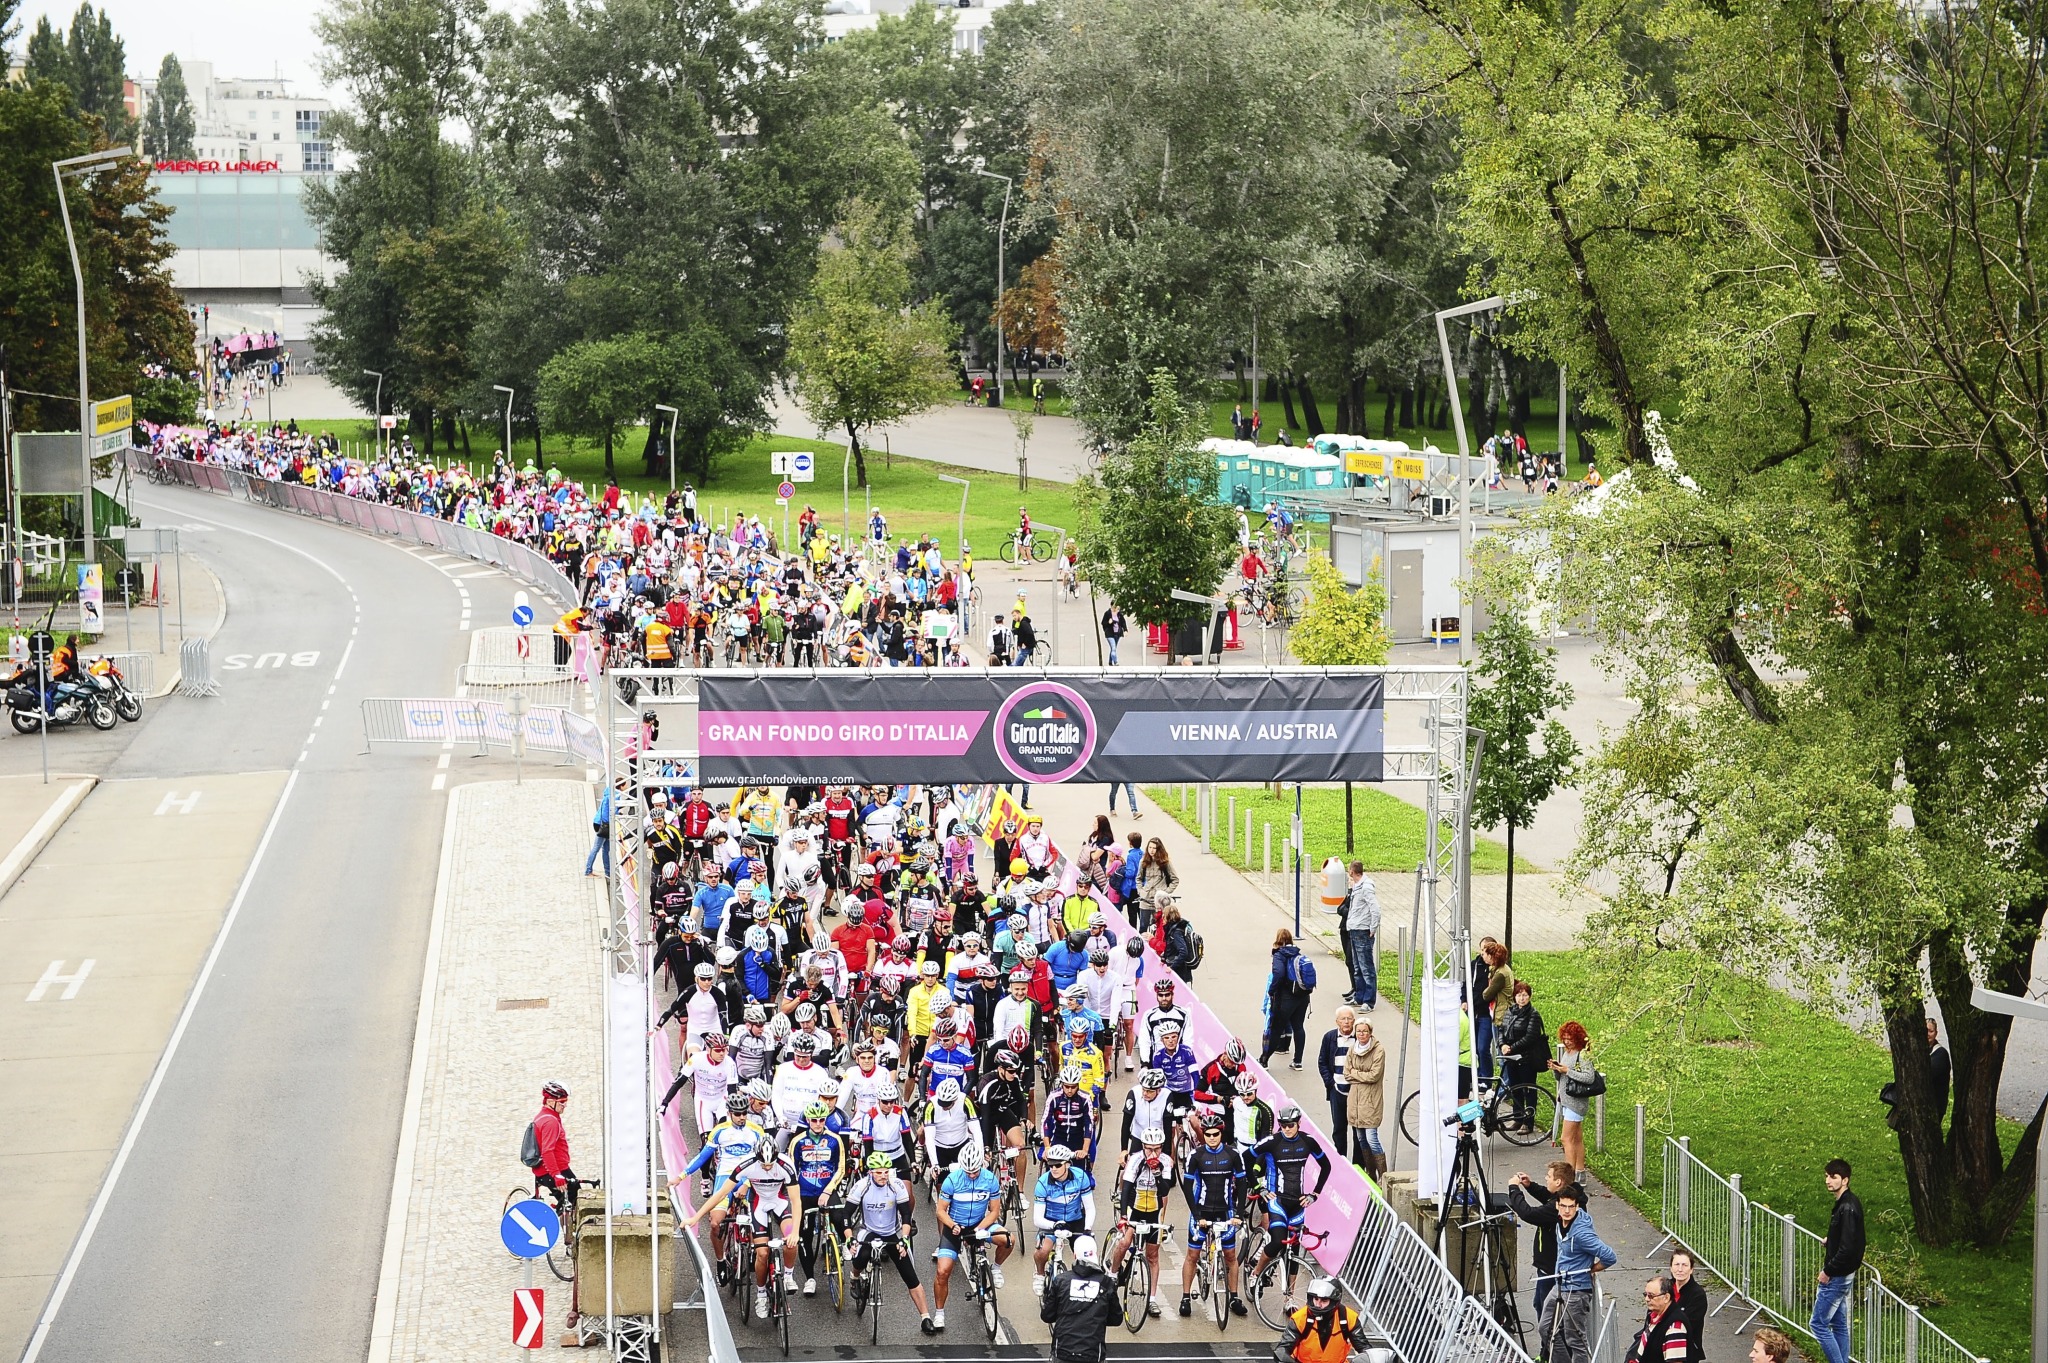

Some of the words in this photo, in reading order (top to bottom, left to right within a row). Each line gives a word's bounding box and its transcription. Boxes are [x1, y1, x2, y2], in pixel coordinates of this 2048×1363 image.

[155, 160, 221, 172] WIENER
[226, 160, 278, 172] LINIEN
[1355, 459, 1382, 470] ERFRISCHENDES
[1404, 463, 1422, 474] IMBISS
[221, 651, 321, 670] BUS
[708, 724, 762, 741] GRAN
[768, 724, 834, 741] FONDO
[838, 724, 884, 741] GIRO
[1010, 722, 1037, 744] Giro
[1038, 722, 1080, 744] d'Italia
[1169, 724, 1241, 741] VIENNA
[1256, 723, 1338, 740] AUSTRIA
[1018, 746, 1042, 755] GRAN
[1043, 745, 1073, 755] FONDO
[707, 774, 855, 786] www.granfondovienna.com
[153, 791, 202, 815] H
[25, 959, 97, 1002] H
